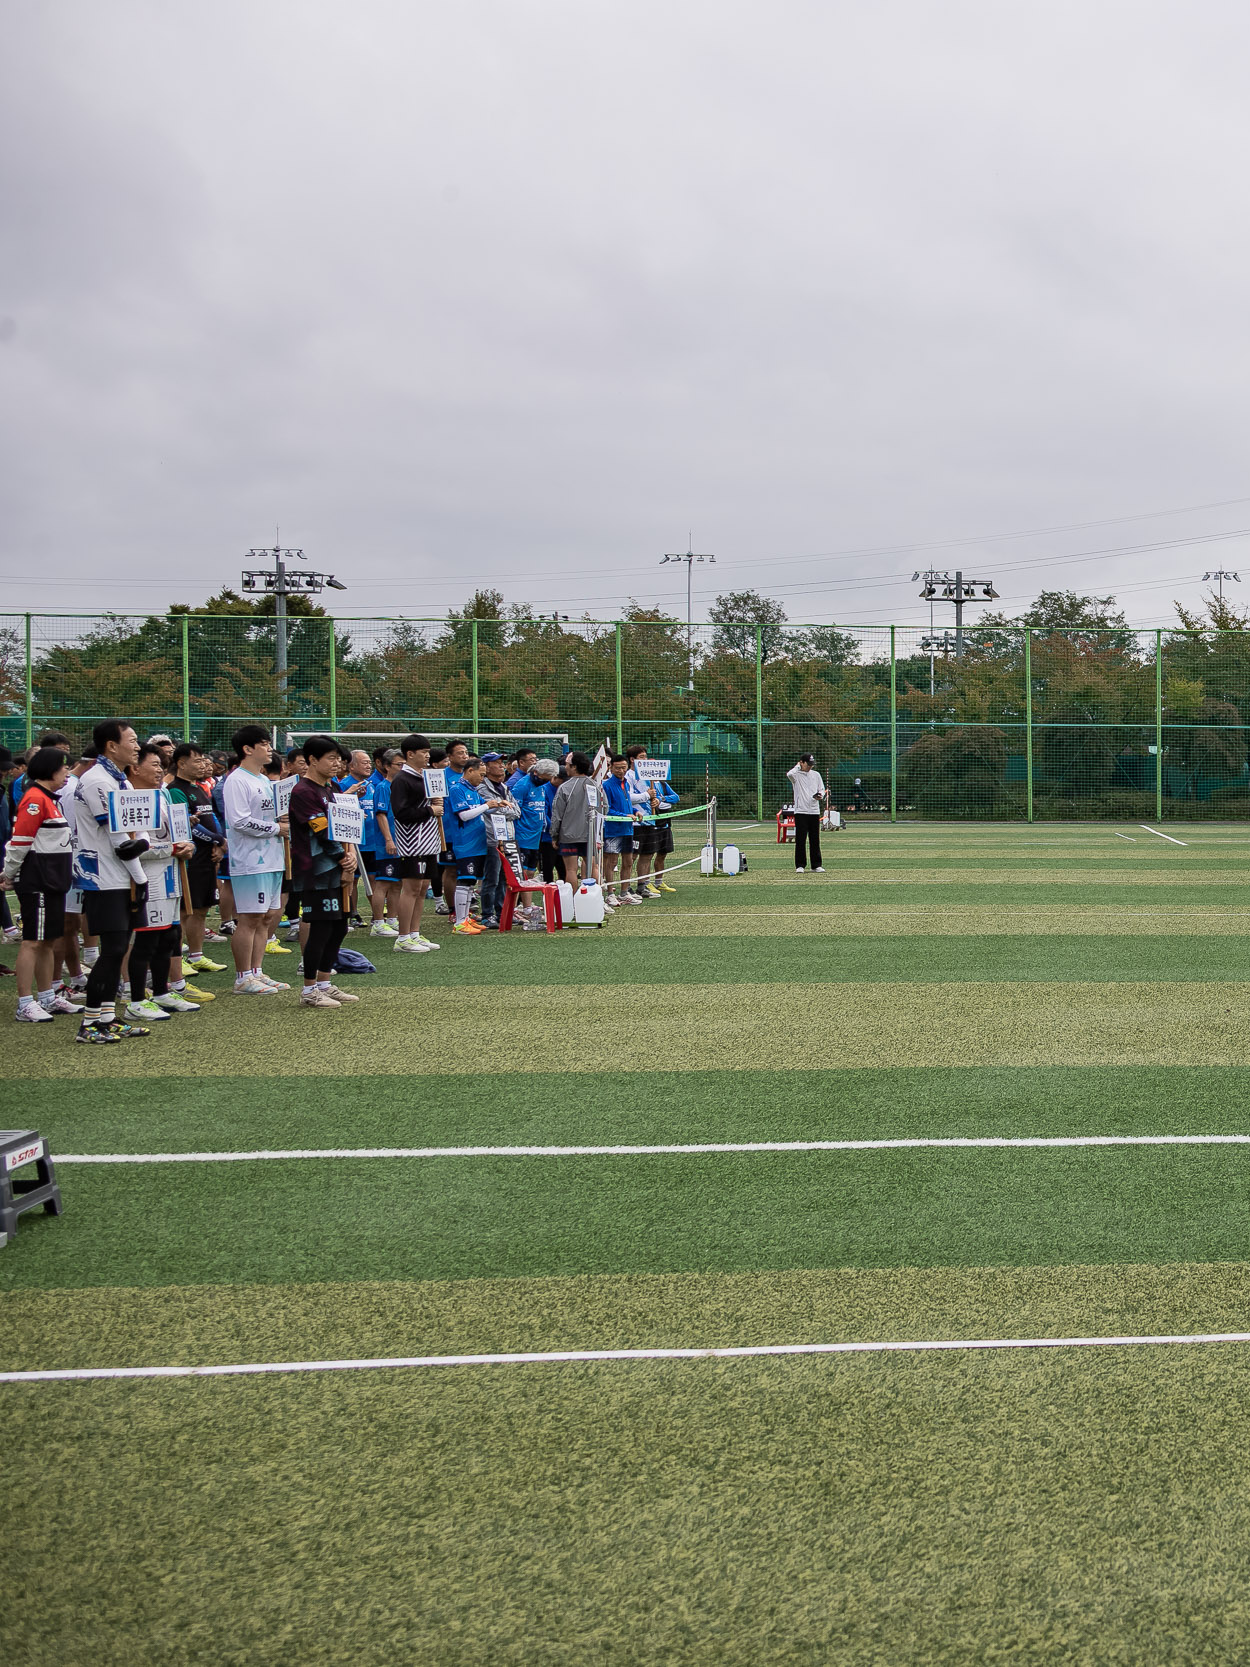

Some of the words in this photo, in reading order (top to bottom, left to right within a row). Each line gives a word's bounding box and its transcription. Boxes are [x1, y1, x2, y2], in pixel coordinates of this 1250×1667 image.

[121, 807, 150, 827] 상록족구
[257, 891, 265, 904] 9
[322, 897, 340, 912] 38
[149, 910, 163, 923] 21
